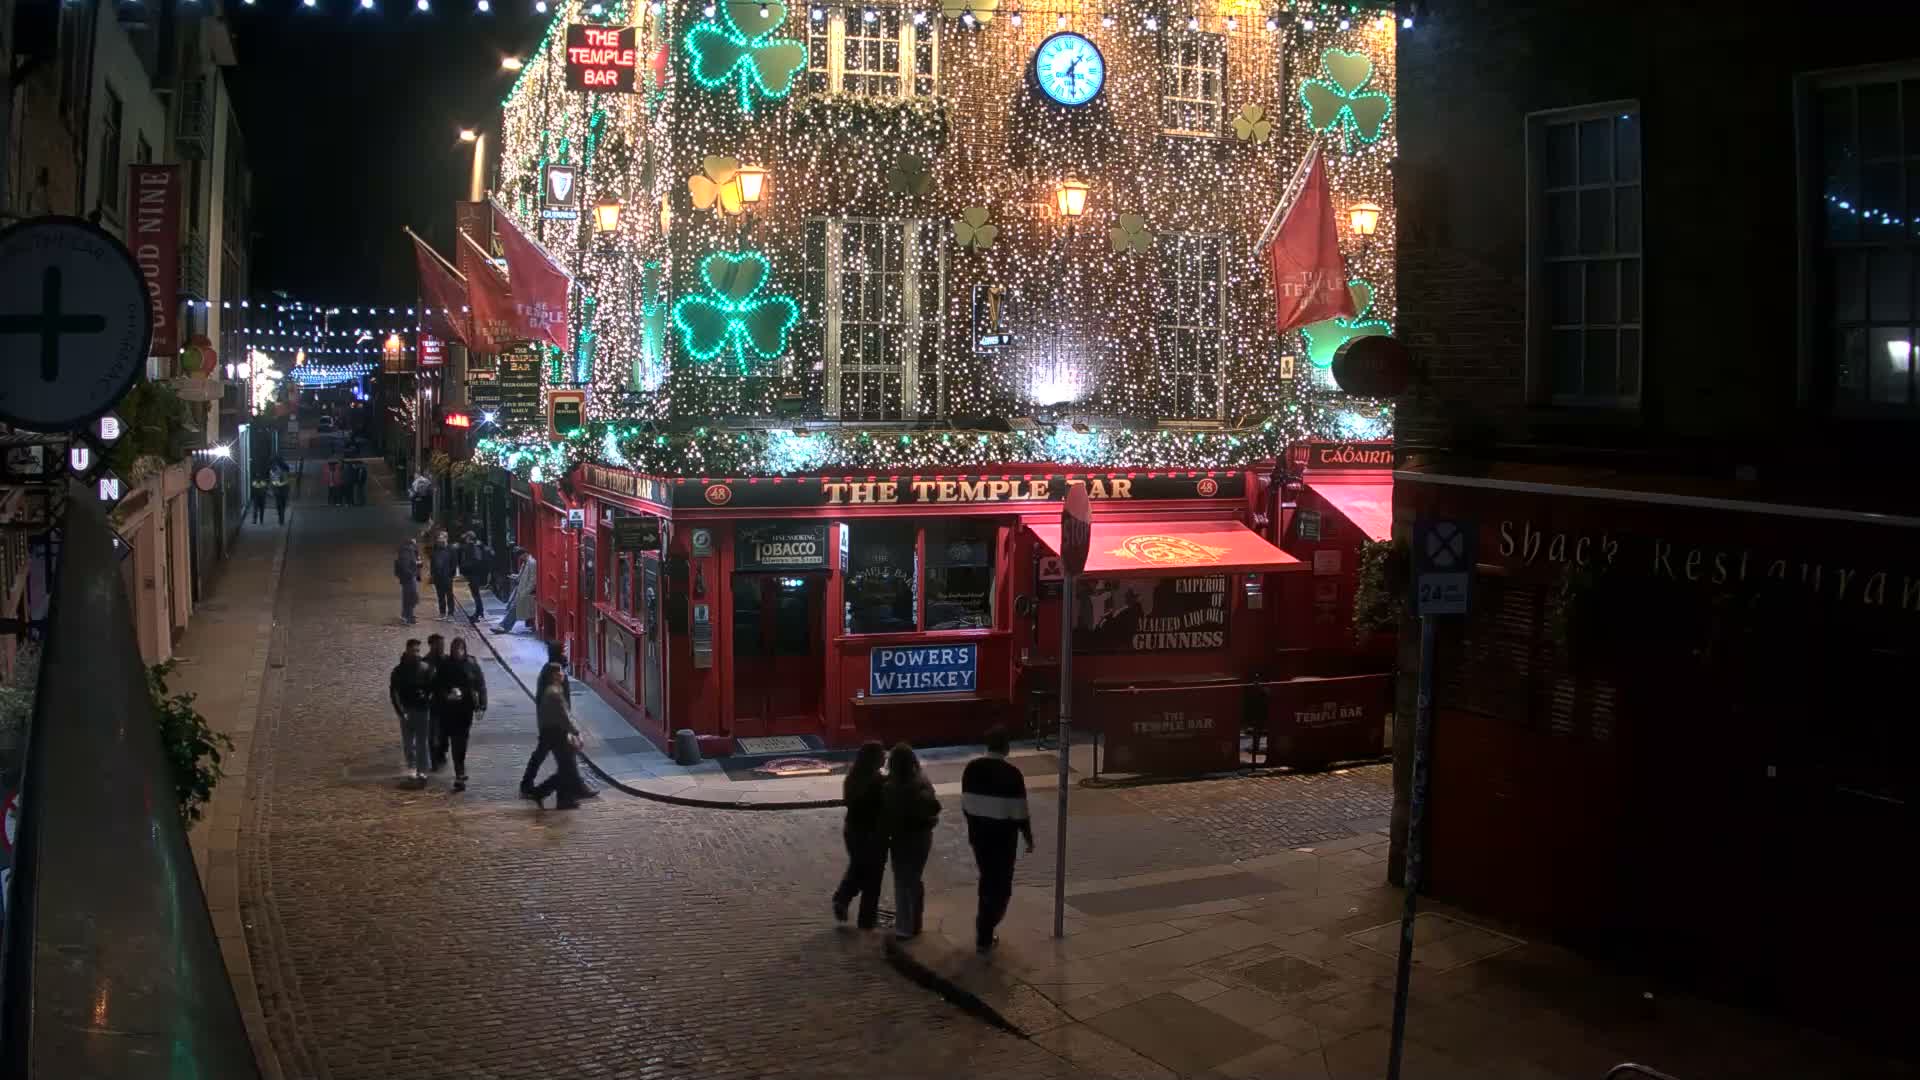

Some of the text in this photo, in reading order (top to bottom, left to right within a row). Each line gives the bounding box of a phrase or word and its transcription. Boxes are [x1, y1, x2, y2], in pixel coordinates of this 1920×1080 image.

[585, 30, 618, 46] THE
[568, 48, 633, 66] TEMPLE
[584, 70, 618, 85] BAR
[137, 172, 170, 232] NINE
[502, 353, 540, 362] TEMPLE
[511, 363, 530, 371] BAR
[607, 473, 635, 496] TEMPLE
[636, 478, 652, 500] BAR
[710, 487, 726, 499] 48
[824, 479, 1132, 503] THE TEMPLE AR
[1200, 481, 1213, 493] 48
[753, 539, 816, 562] TOBACCO
[1175, 577, 1225, 593] EMPEROR
[1211, 593, 1224, 607] OF
[1137, 615, 1181, 633] MALTED
[1132, 631, 1224, 650] GUINNESS
[880, 648, 969, 668] POWER'S
[873, 670, 974, 690] WHISKEY
